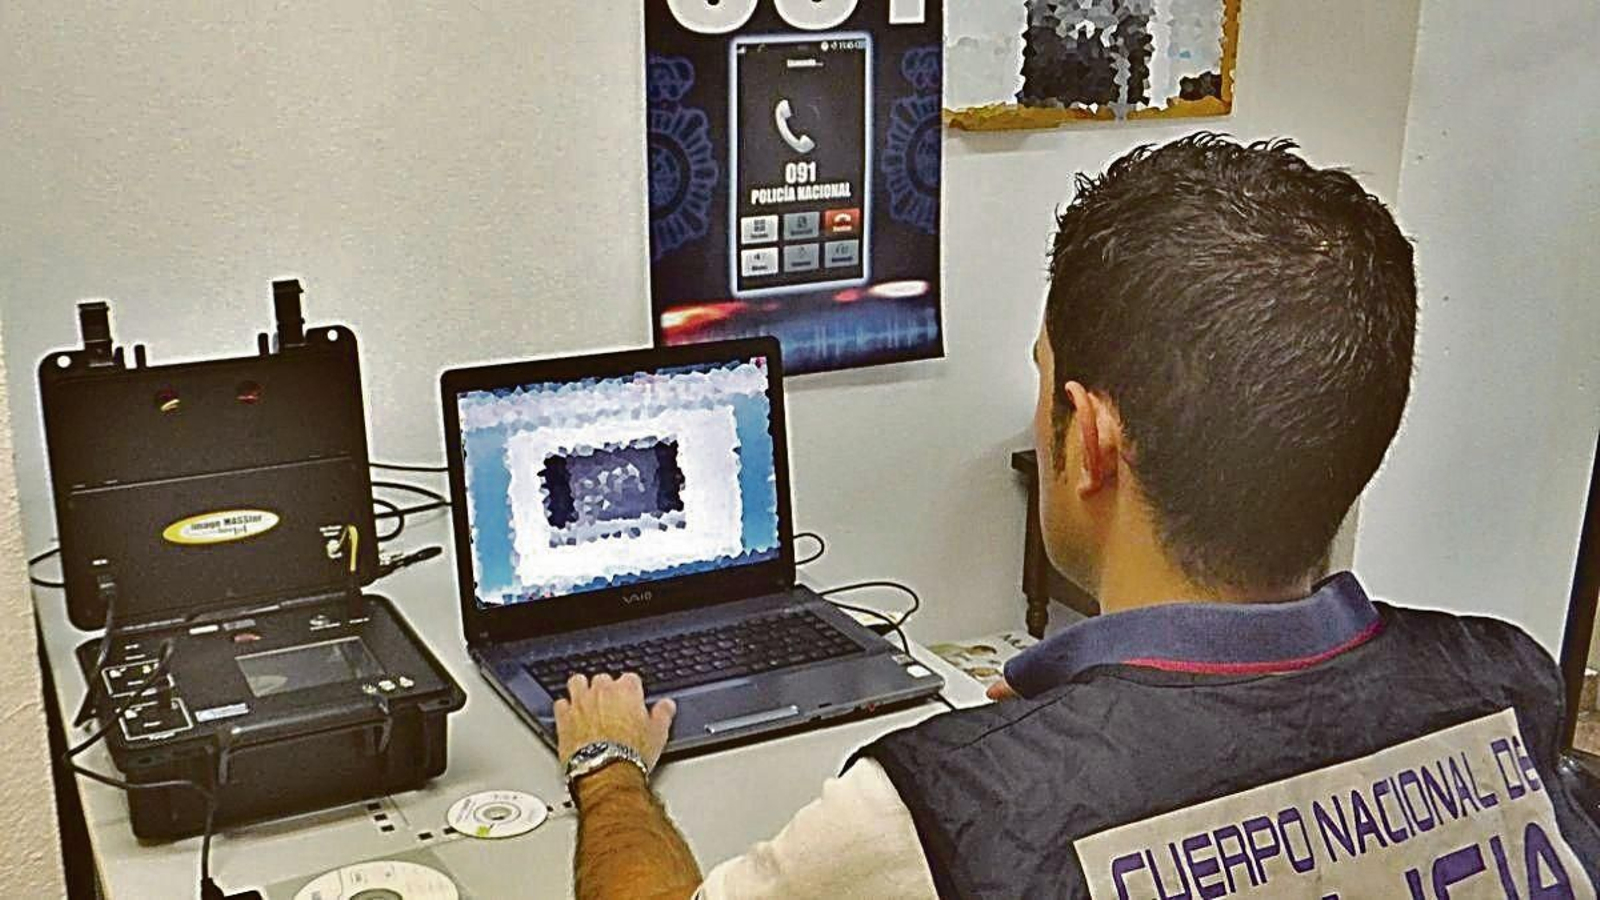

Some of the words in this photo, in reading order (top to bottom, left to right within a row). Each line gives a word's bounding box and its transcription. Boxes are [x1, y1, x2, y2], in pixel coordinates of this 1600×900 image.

[785, 161, 816, 184] 091
[751, 184, 796, 205] POLICÍA
[797, 182, 851, 201] NACIONAL
[1112, 807, 1315, 900] CUERPO
[1312, 751, 1499, 863] NACIONAL
